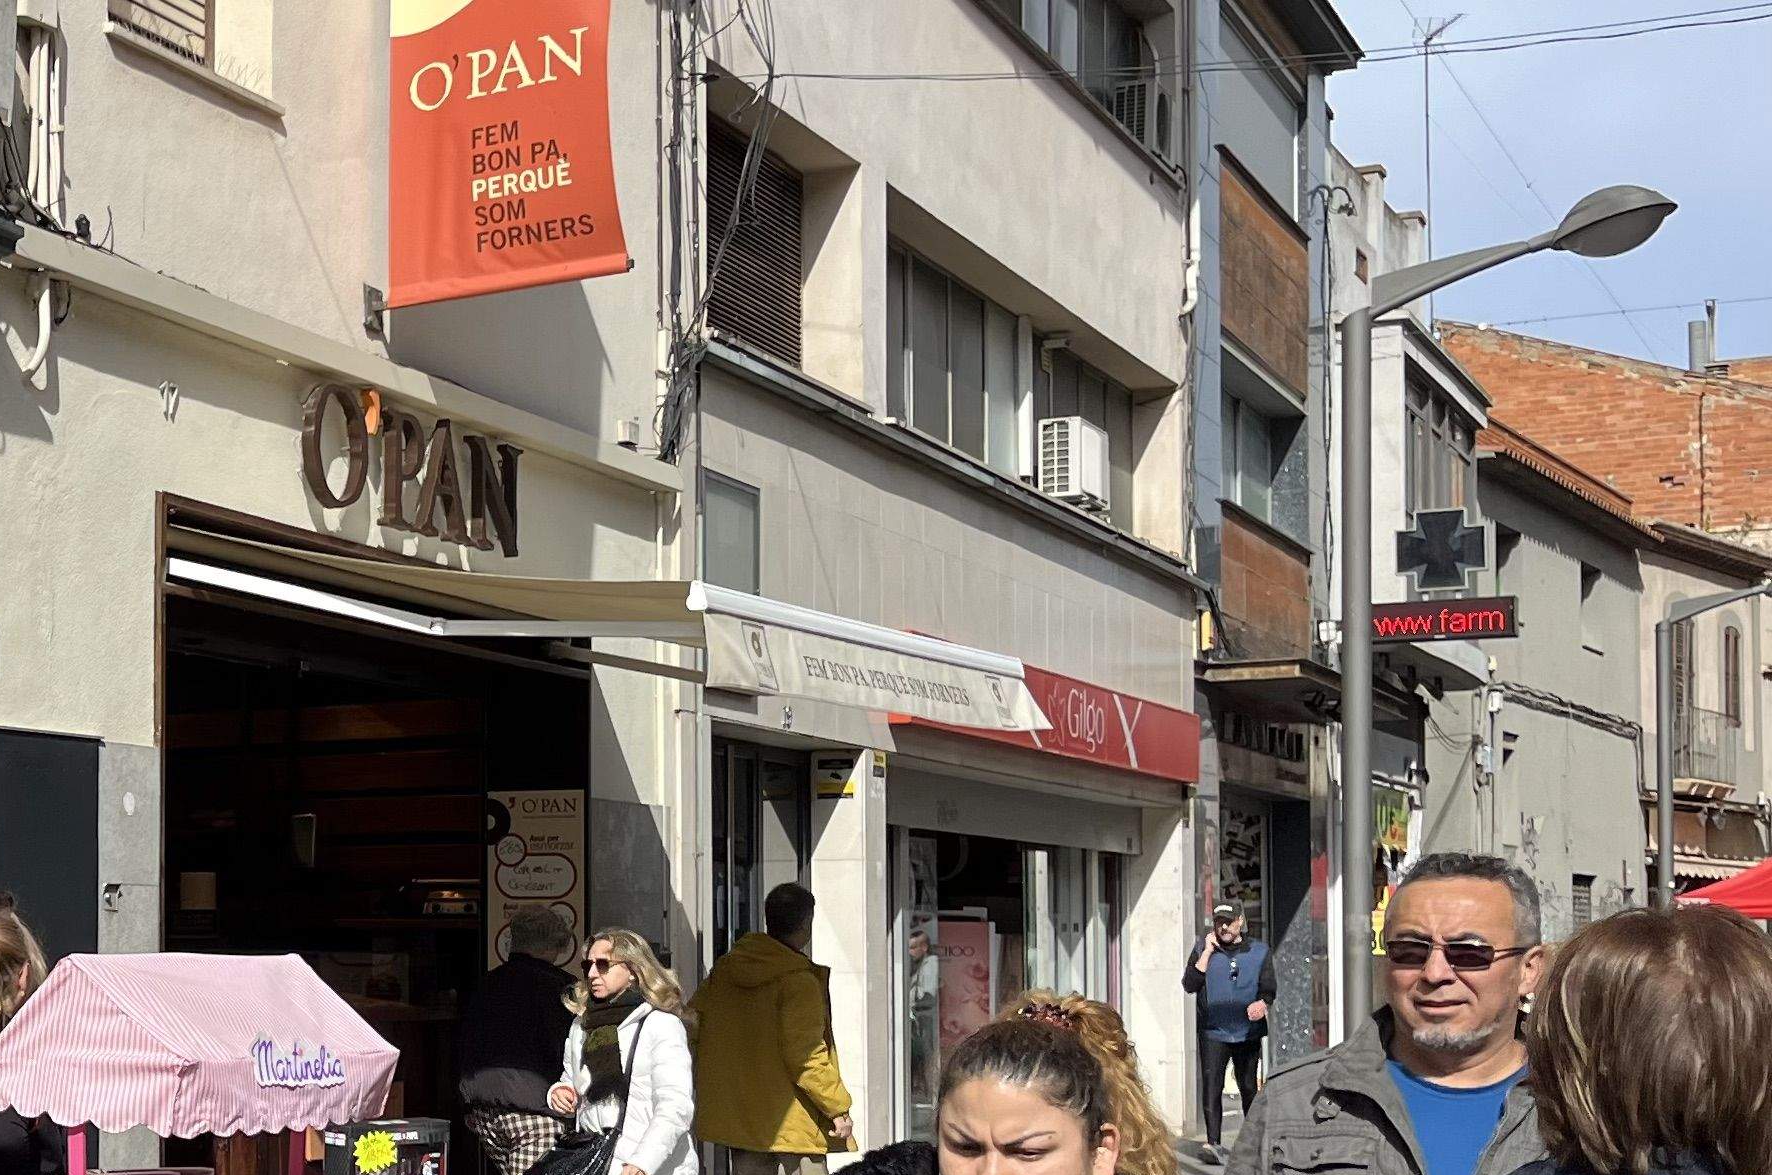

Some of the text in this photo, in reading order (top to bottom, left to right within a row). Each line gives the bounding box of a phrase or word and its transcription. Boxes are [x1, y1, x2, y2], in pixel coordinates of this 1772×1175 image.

[409, 26, 589, 111] O'PAN
[471, 121, 519, 149] FEM
[472, 140, 567, 174] BON PA,
[472, 158, 572, 201] PERQUÈ
[475, 198, 526, 226] SOM
[476, 214, 594, 252] FORNERS
[159, 381, 180, 424] 17
[300, 383, 525, 557] O'PAN
[1439, 607, 1504, 633] farm
[803, 656, 828, 679] FEM
[828, 661, 852, 683] BON
[908, 678, 928, 699] SOM
[928, 681, 970, 706] FORNERS
[1067, 687, 1106, 752] Gilgo
[522, 799, 577, 813] O'PAN
[253, 1038, 344, 1082] Martinelia
